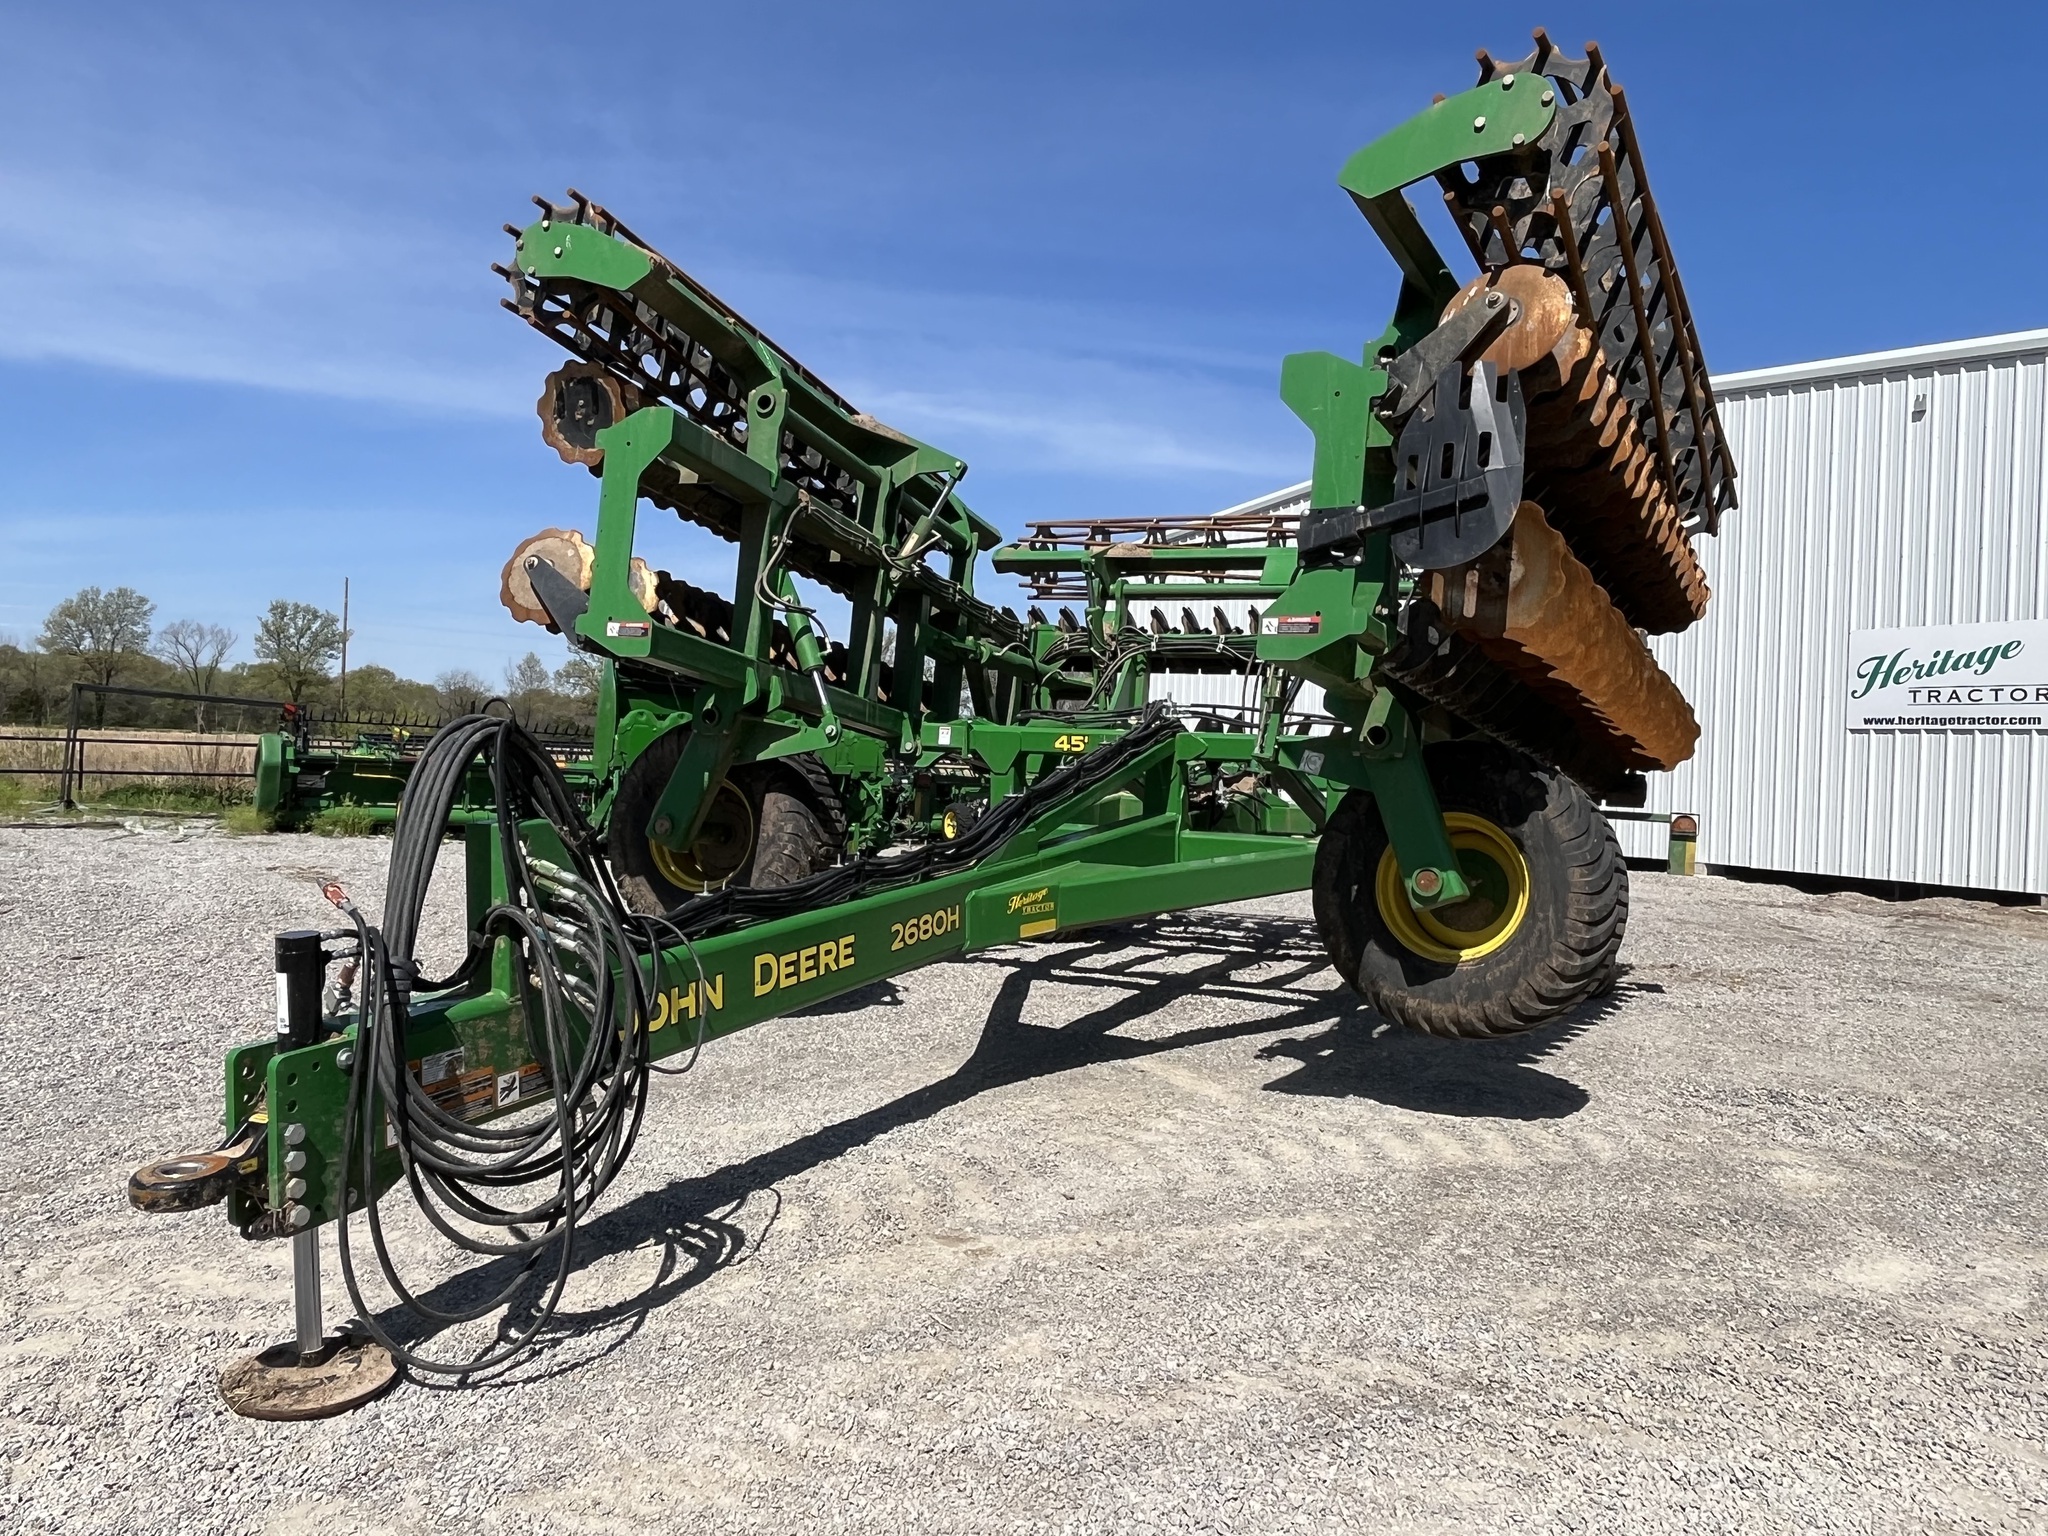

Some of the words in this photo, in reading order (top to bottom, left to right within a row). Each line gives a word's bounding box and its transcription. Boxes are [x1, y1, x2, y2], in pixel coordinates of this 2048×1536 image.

[1851, 640, 2025, 699] Heritage
[1908, 687, 2048, 703] TRACTOR
[1863, 716, 2042, 726] www.heritagetractor.com
[754, 934, 855, 997] DEERE
[890, 904, 960, 951] 2680H
